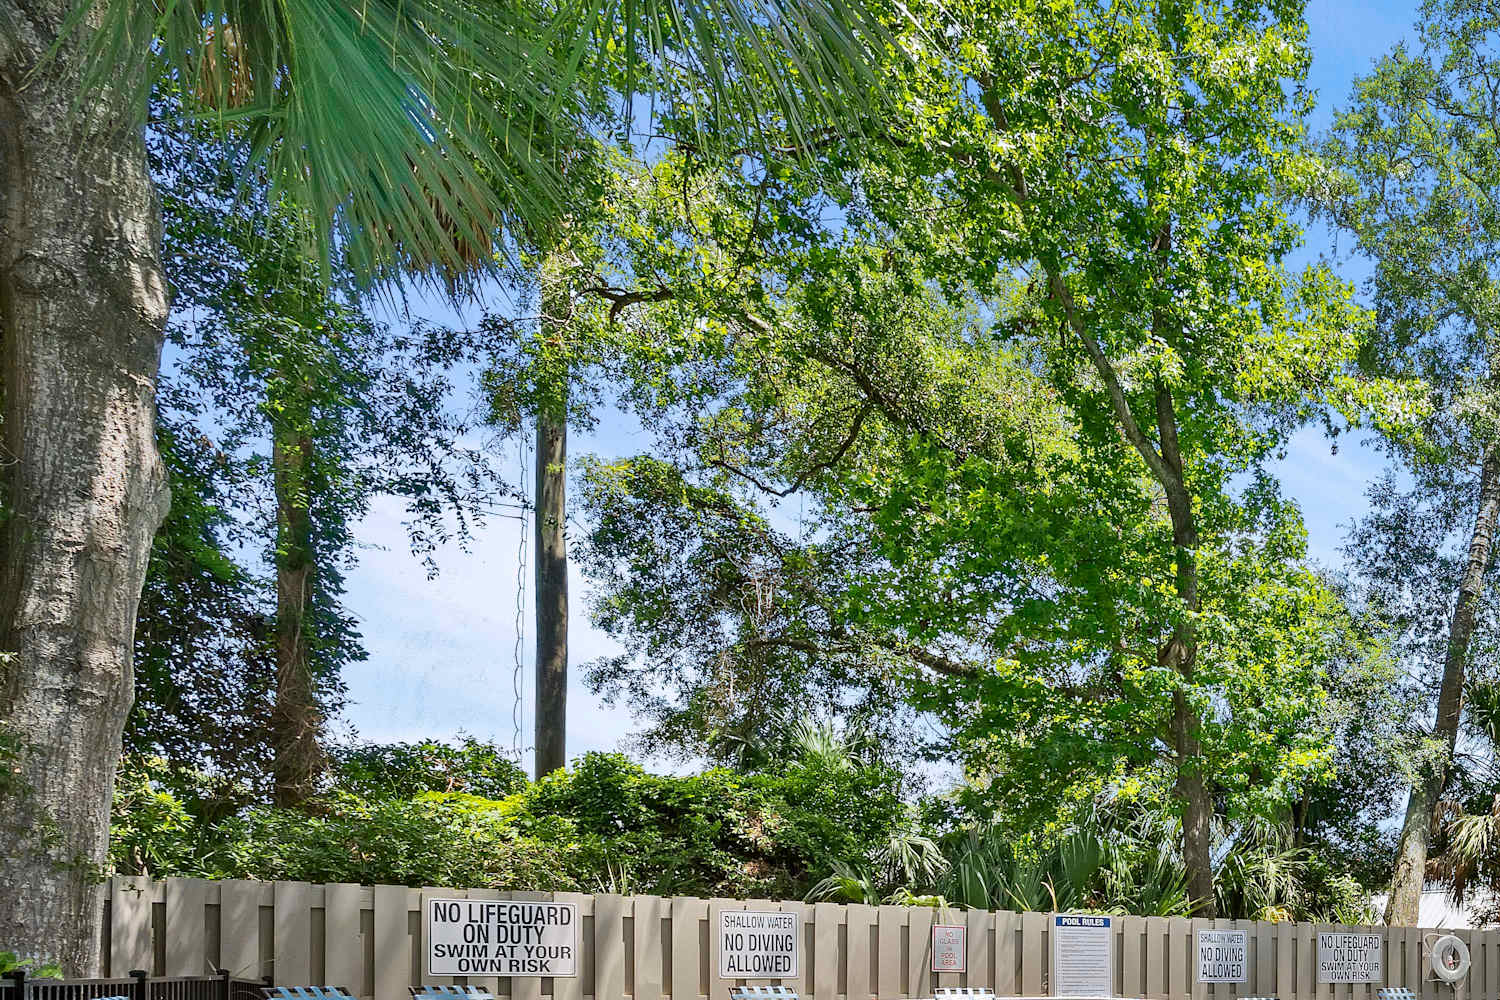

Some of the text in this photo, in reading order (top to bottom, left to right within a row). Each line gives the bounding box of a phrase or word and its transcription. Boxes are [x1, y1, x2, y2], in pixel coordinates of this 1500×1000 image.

[434, 902, 571, 926] NO LIFEGUARD
[724, 915, 793, 929] SHALLOW WATER
[1062, 917, 1104, 927] POOL RULES
[463, 923, 545, 945] ON DUTY
[725, 933, 793, 952] NO DIVING
[1321, 935, 1380, 949] NO LIFEGUARD
[434, 944, 571, 959] SWIM AT YOUR
[1200, 947, 1243, 962] NO DIVING
[1333, 948, 1368, 962] ON DUTY
[458, 958, 551, 973] OWN RISK
[727, 954, 791, 972] ALLOWED
[1202, 963, 1242, 978] ALLOWED
[1321, 962, 1380, 971] SWIM AT YOUR
[1331, 971, 1370, 981] OWN RISK
